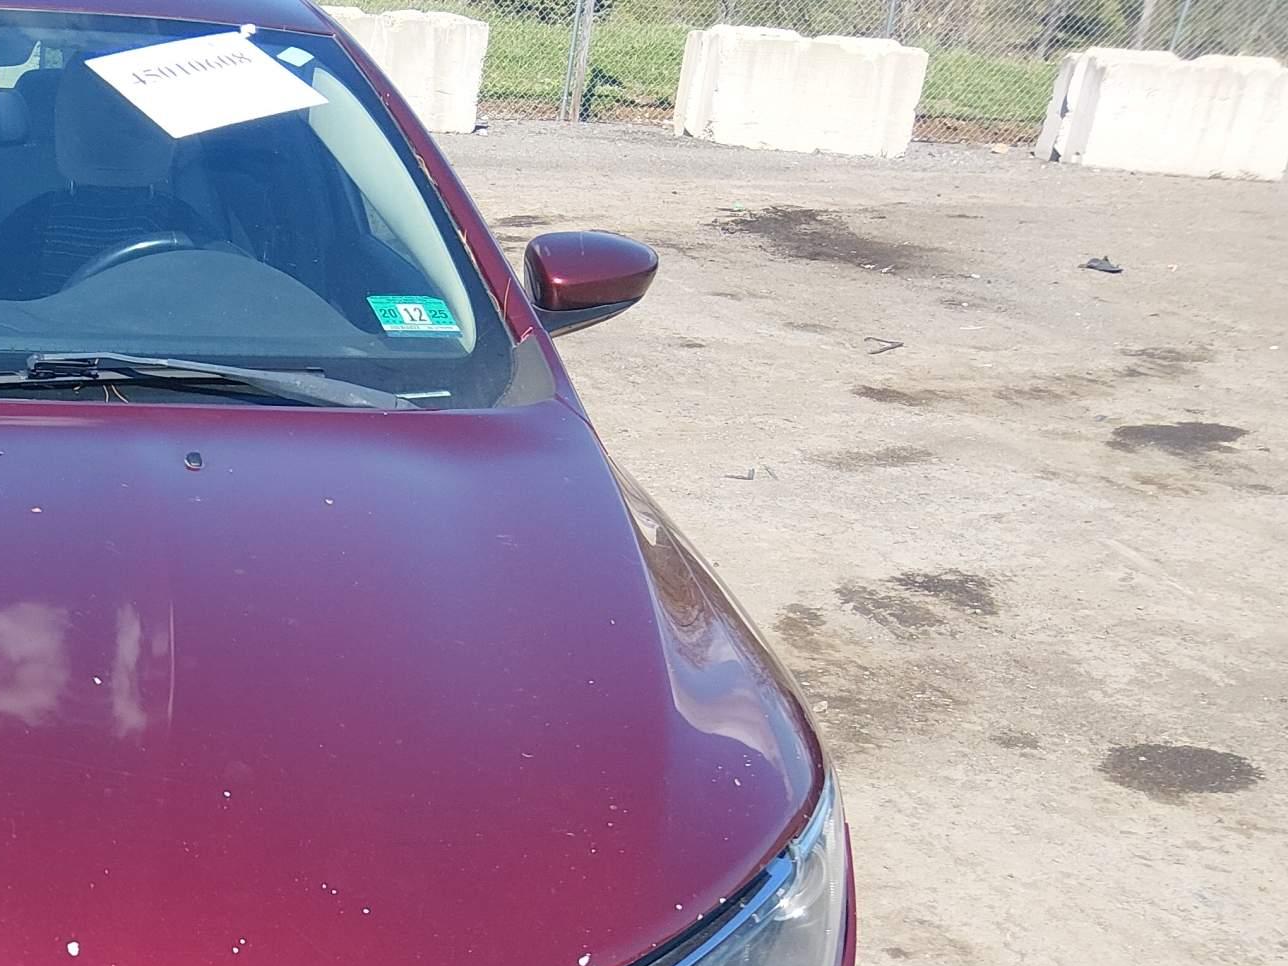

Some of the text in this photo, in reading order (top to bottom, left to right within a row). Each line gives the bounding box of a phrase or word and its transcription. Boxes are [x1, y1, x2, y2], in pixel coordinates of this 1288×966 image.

[131, 51, 253, 85] 45010608
[379, 306, 449, 322] 20 12 25
